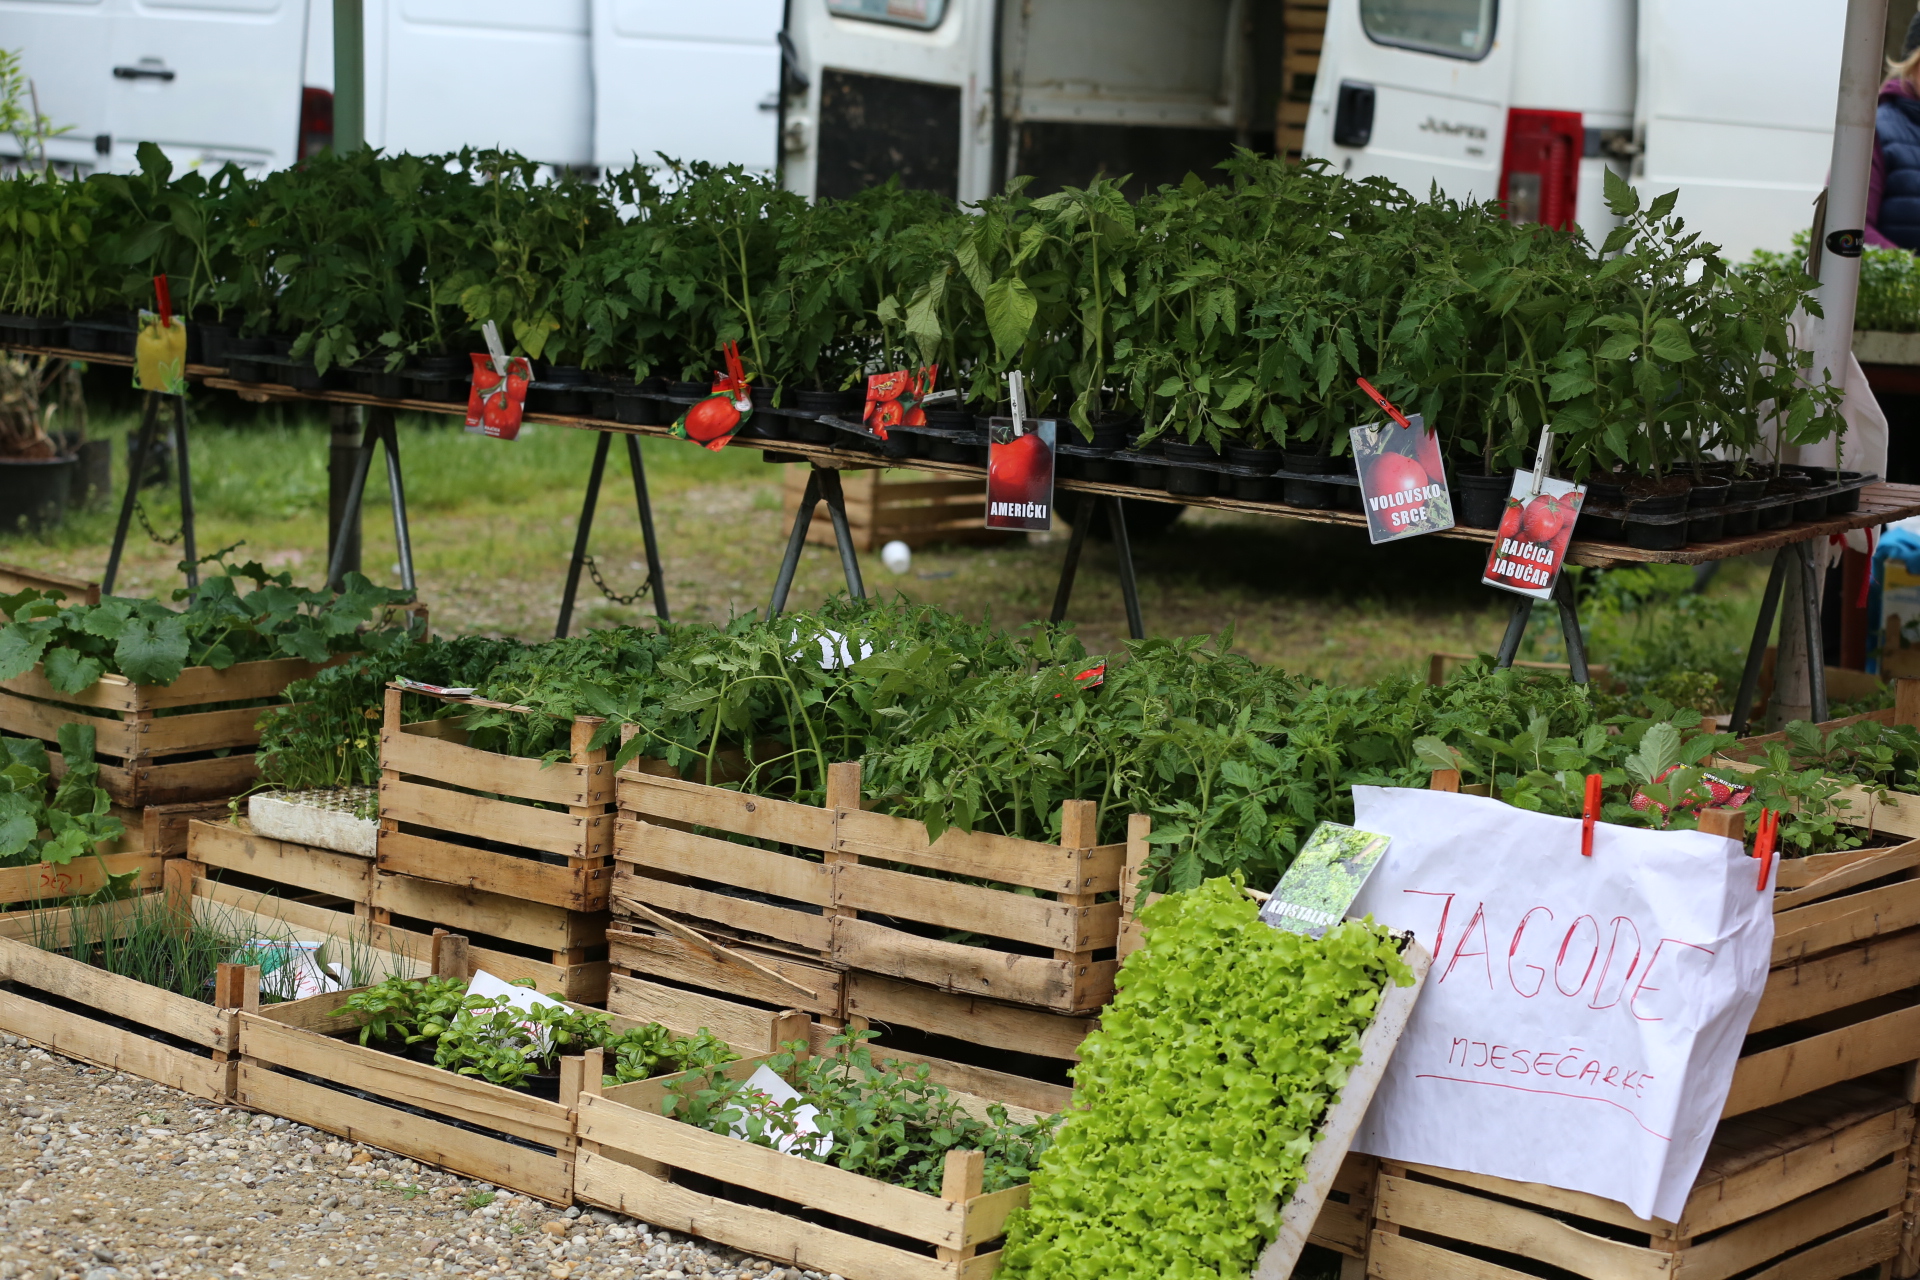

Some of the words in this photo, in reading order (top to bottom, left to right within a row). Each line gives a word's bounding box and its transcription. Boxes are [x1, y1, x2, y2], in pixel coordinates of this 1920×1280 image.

[990, 501, 1047, 519] AMERIČKI
[1369, 483, 1441, 512] VOLOVSKO
[1392, 507, 1428, 527] SRCE
[1501, 537, 1554, 566] RAJČICA
[1492, 557, 1550, 587] JABUČAR
[1267, 899, 1336, 926] KRISTALKA
[1403, 889, 1715, 1021] JAGODE
[1449, 1037, 1654, 1098] MJESEČARKE
